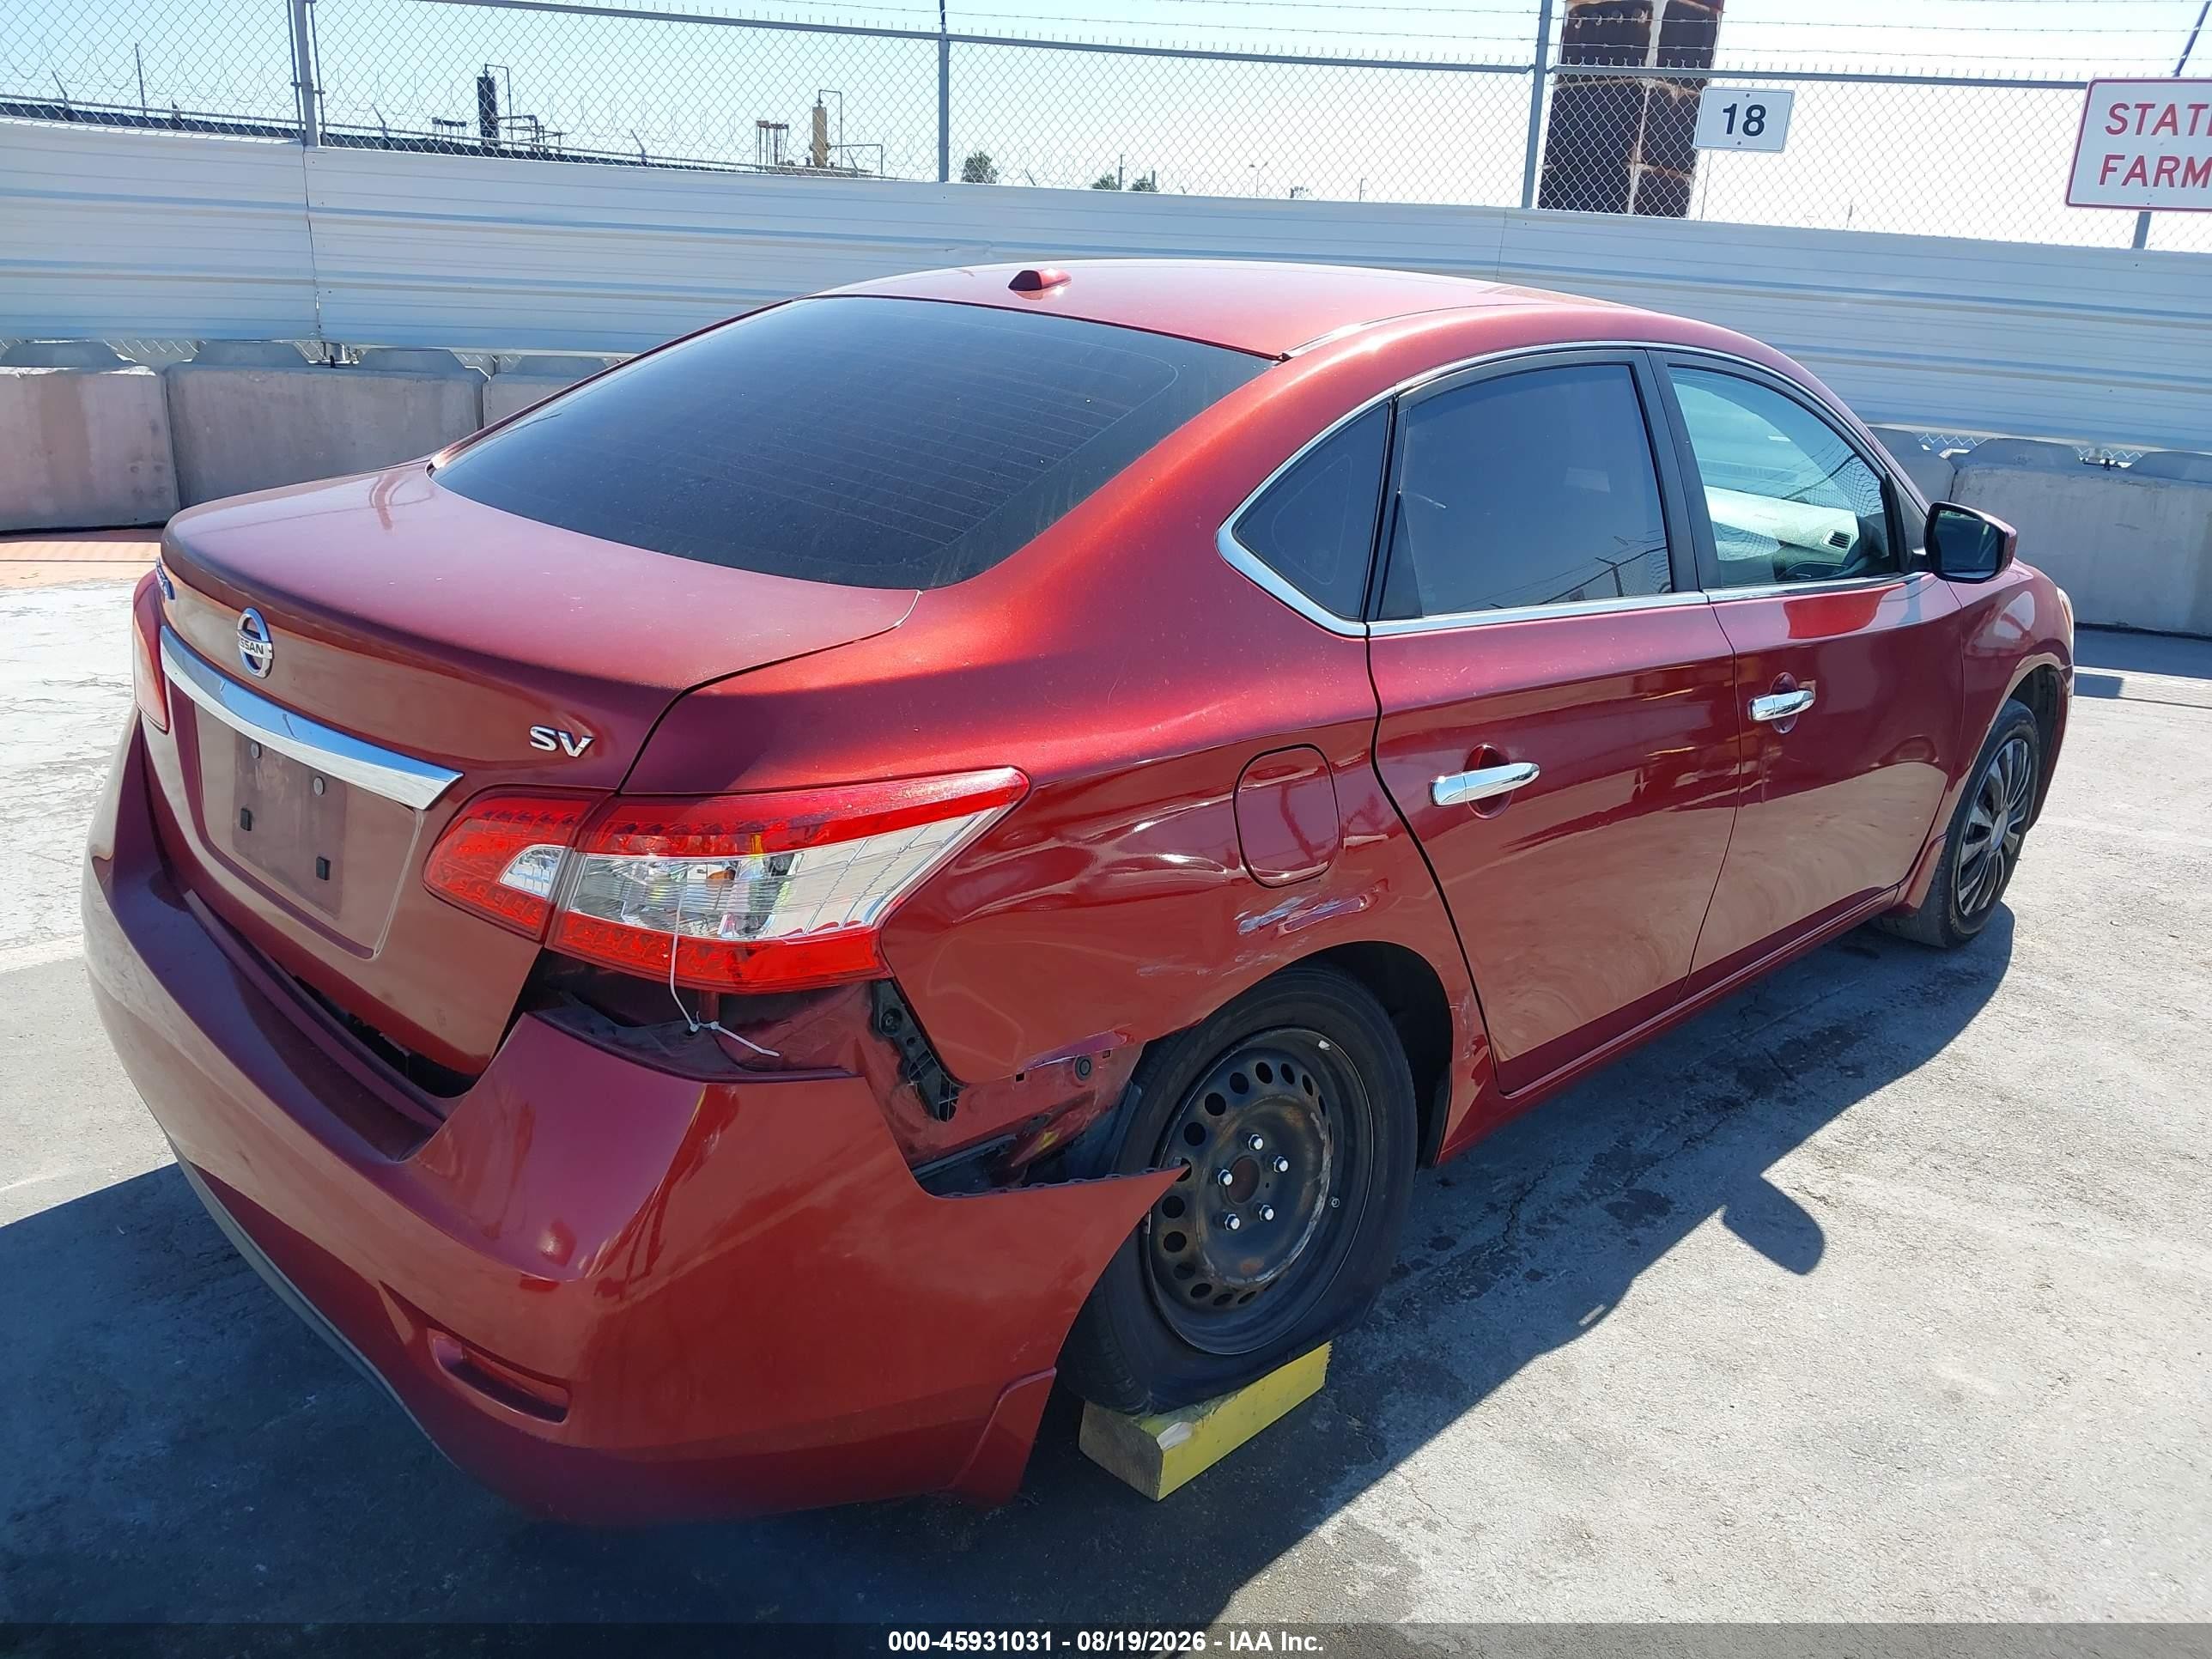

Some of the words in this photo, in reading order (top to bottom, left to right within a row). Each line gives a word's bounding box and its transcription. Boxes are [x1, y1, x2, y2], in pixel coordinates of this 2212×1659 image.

[1723, 103, 1766, 137] 18
[2105, 103, 2212, 137] STAT
[2099, 154, 2212, 189] FARM
[529, 725, 594, 757] SV
